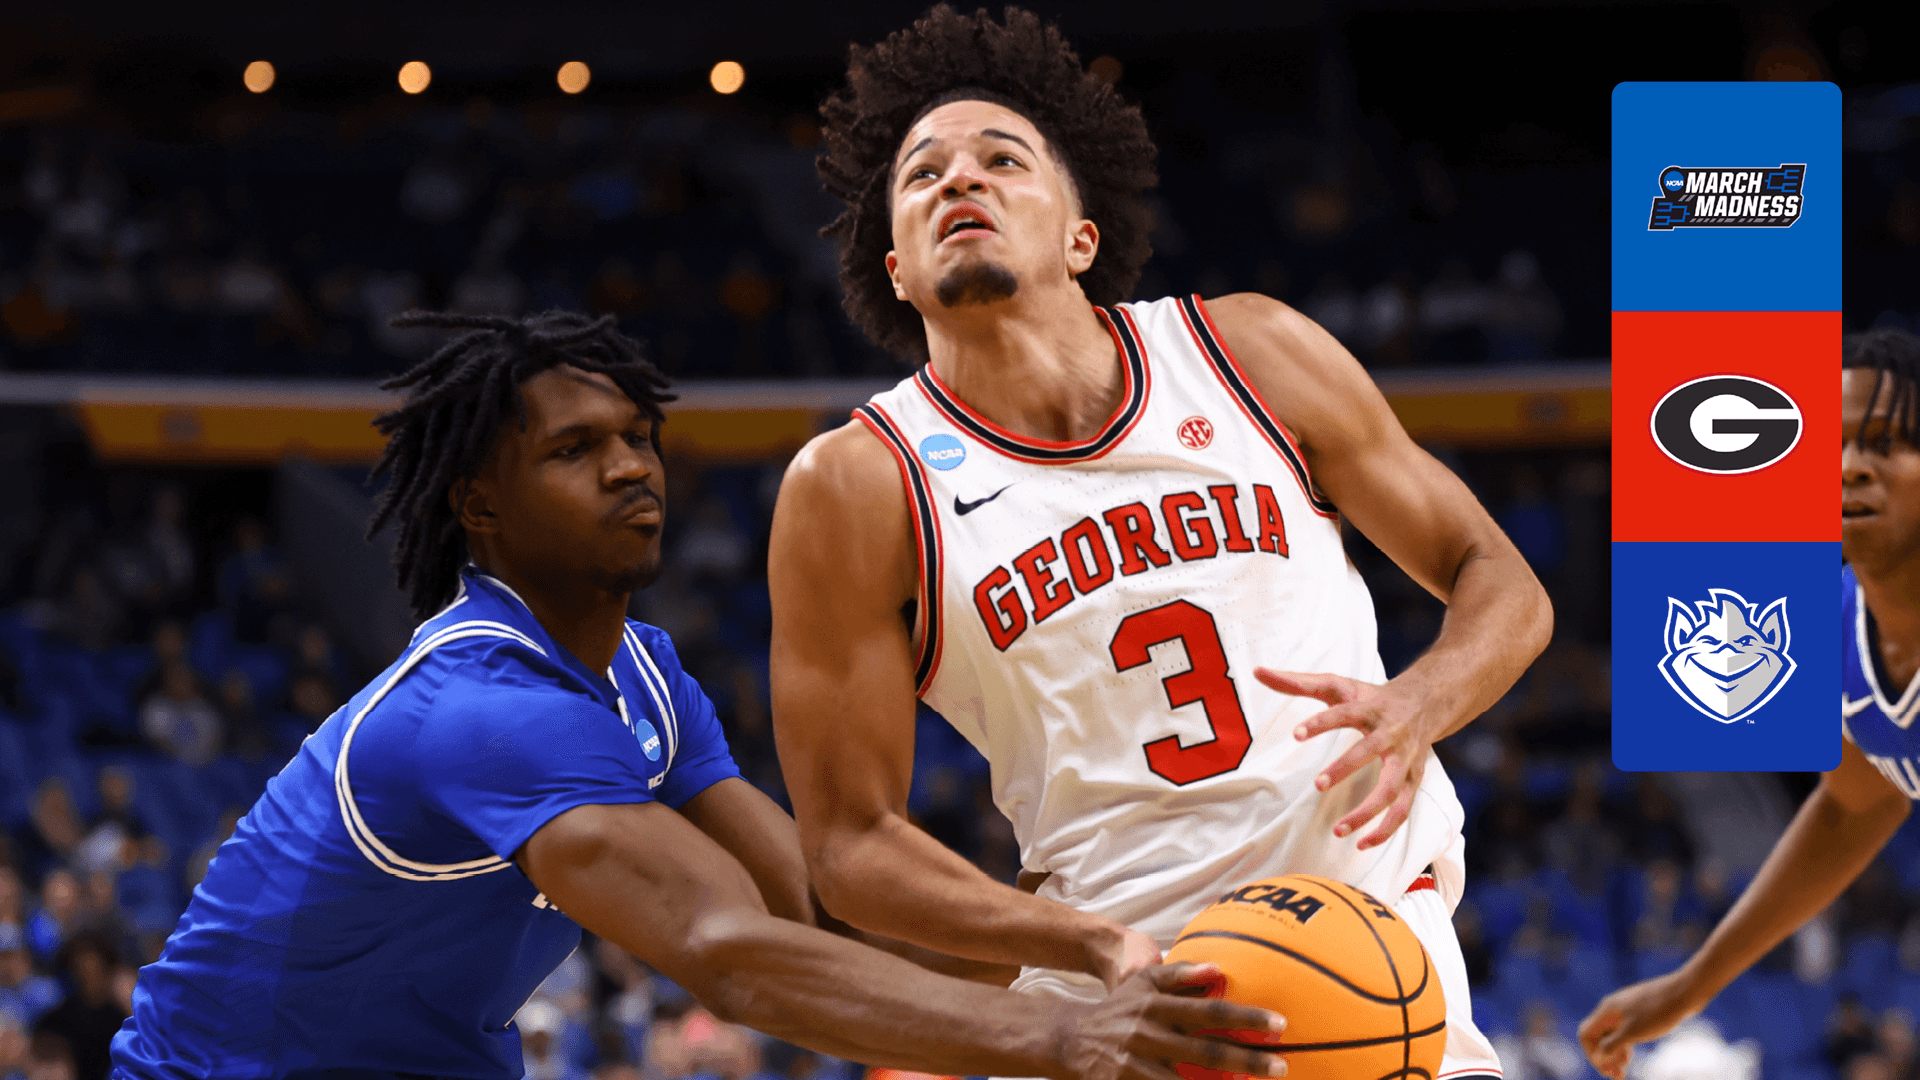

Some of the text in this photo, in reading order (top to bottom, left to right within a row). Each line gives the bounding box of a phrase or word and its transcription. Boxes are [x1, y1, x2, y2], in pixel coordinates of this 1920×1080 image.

[927, 448, 965, 461] NCAA
[1181, 419, 1211, 448] SEC
[973, 483, 1289, 652] GEORGIA
[1109, 598, 1253, 787] 3
